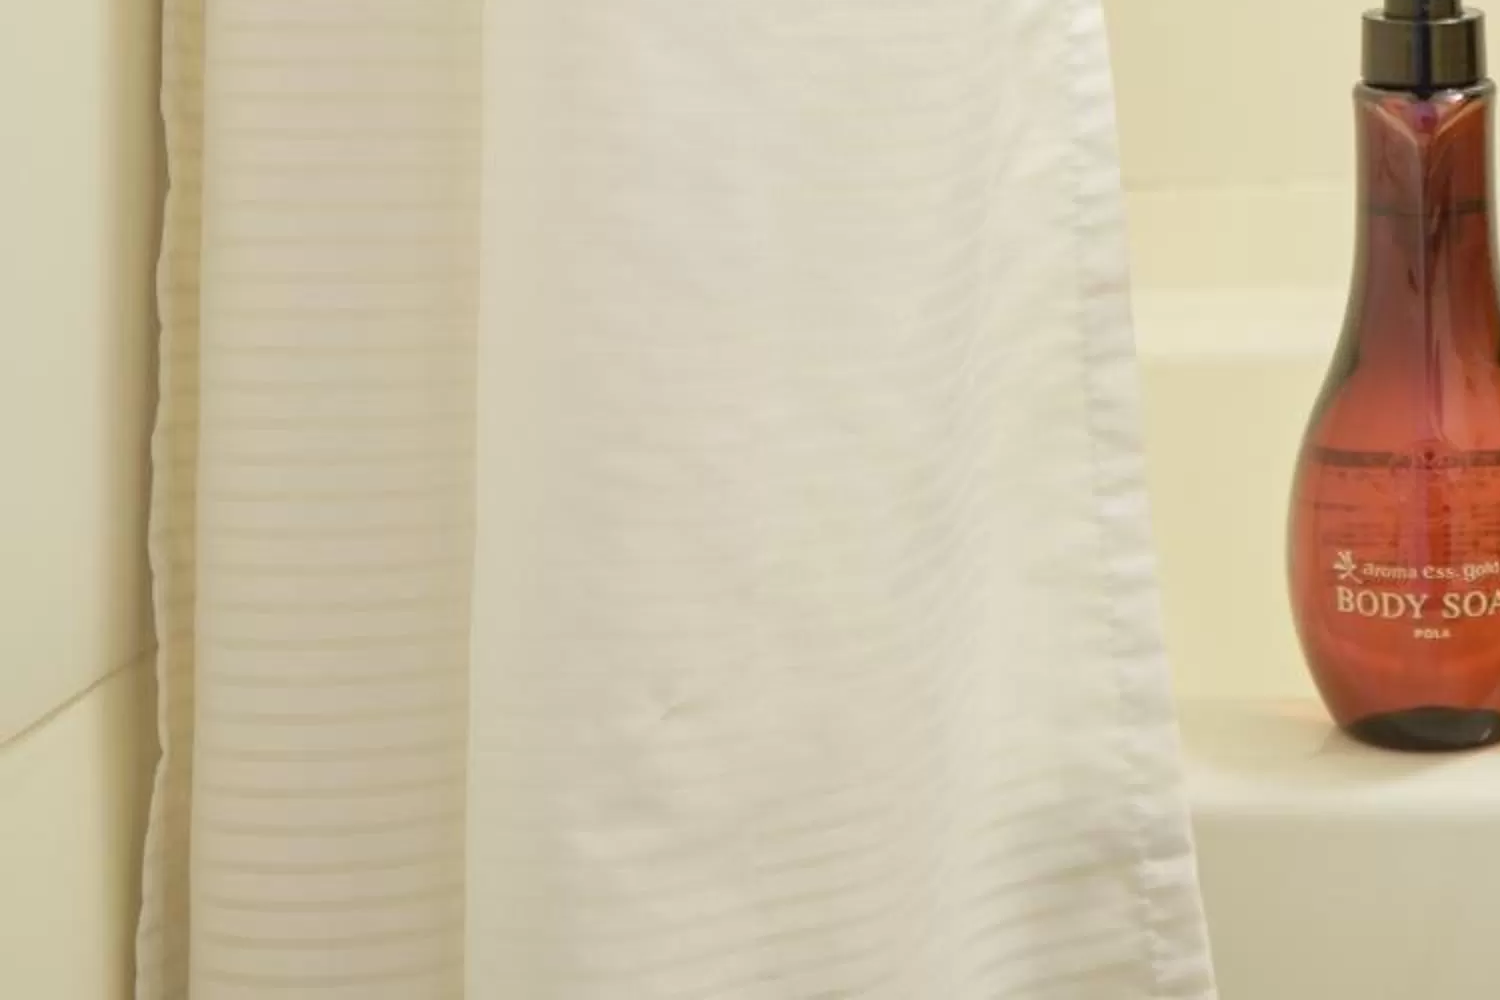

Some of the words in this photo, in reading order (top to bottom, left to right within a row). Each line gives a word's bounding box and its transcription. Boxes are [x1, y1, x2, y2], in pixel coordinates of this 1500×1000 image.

[1363, 560, 1417, 579] aroma
[1463, 559, 1500, 581] gold
[1336, 585, 1428, 619] BODY
